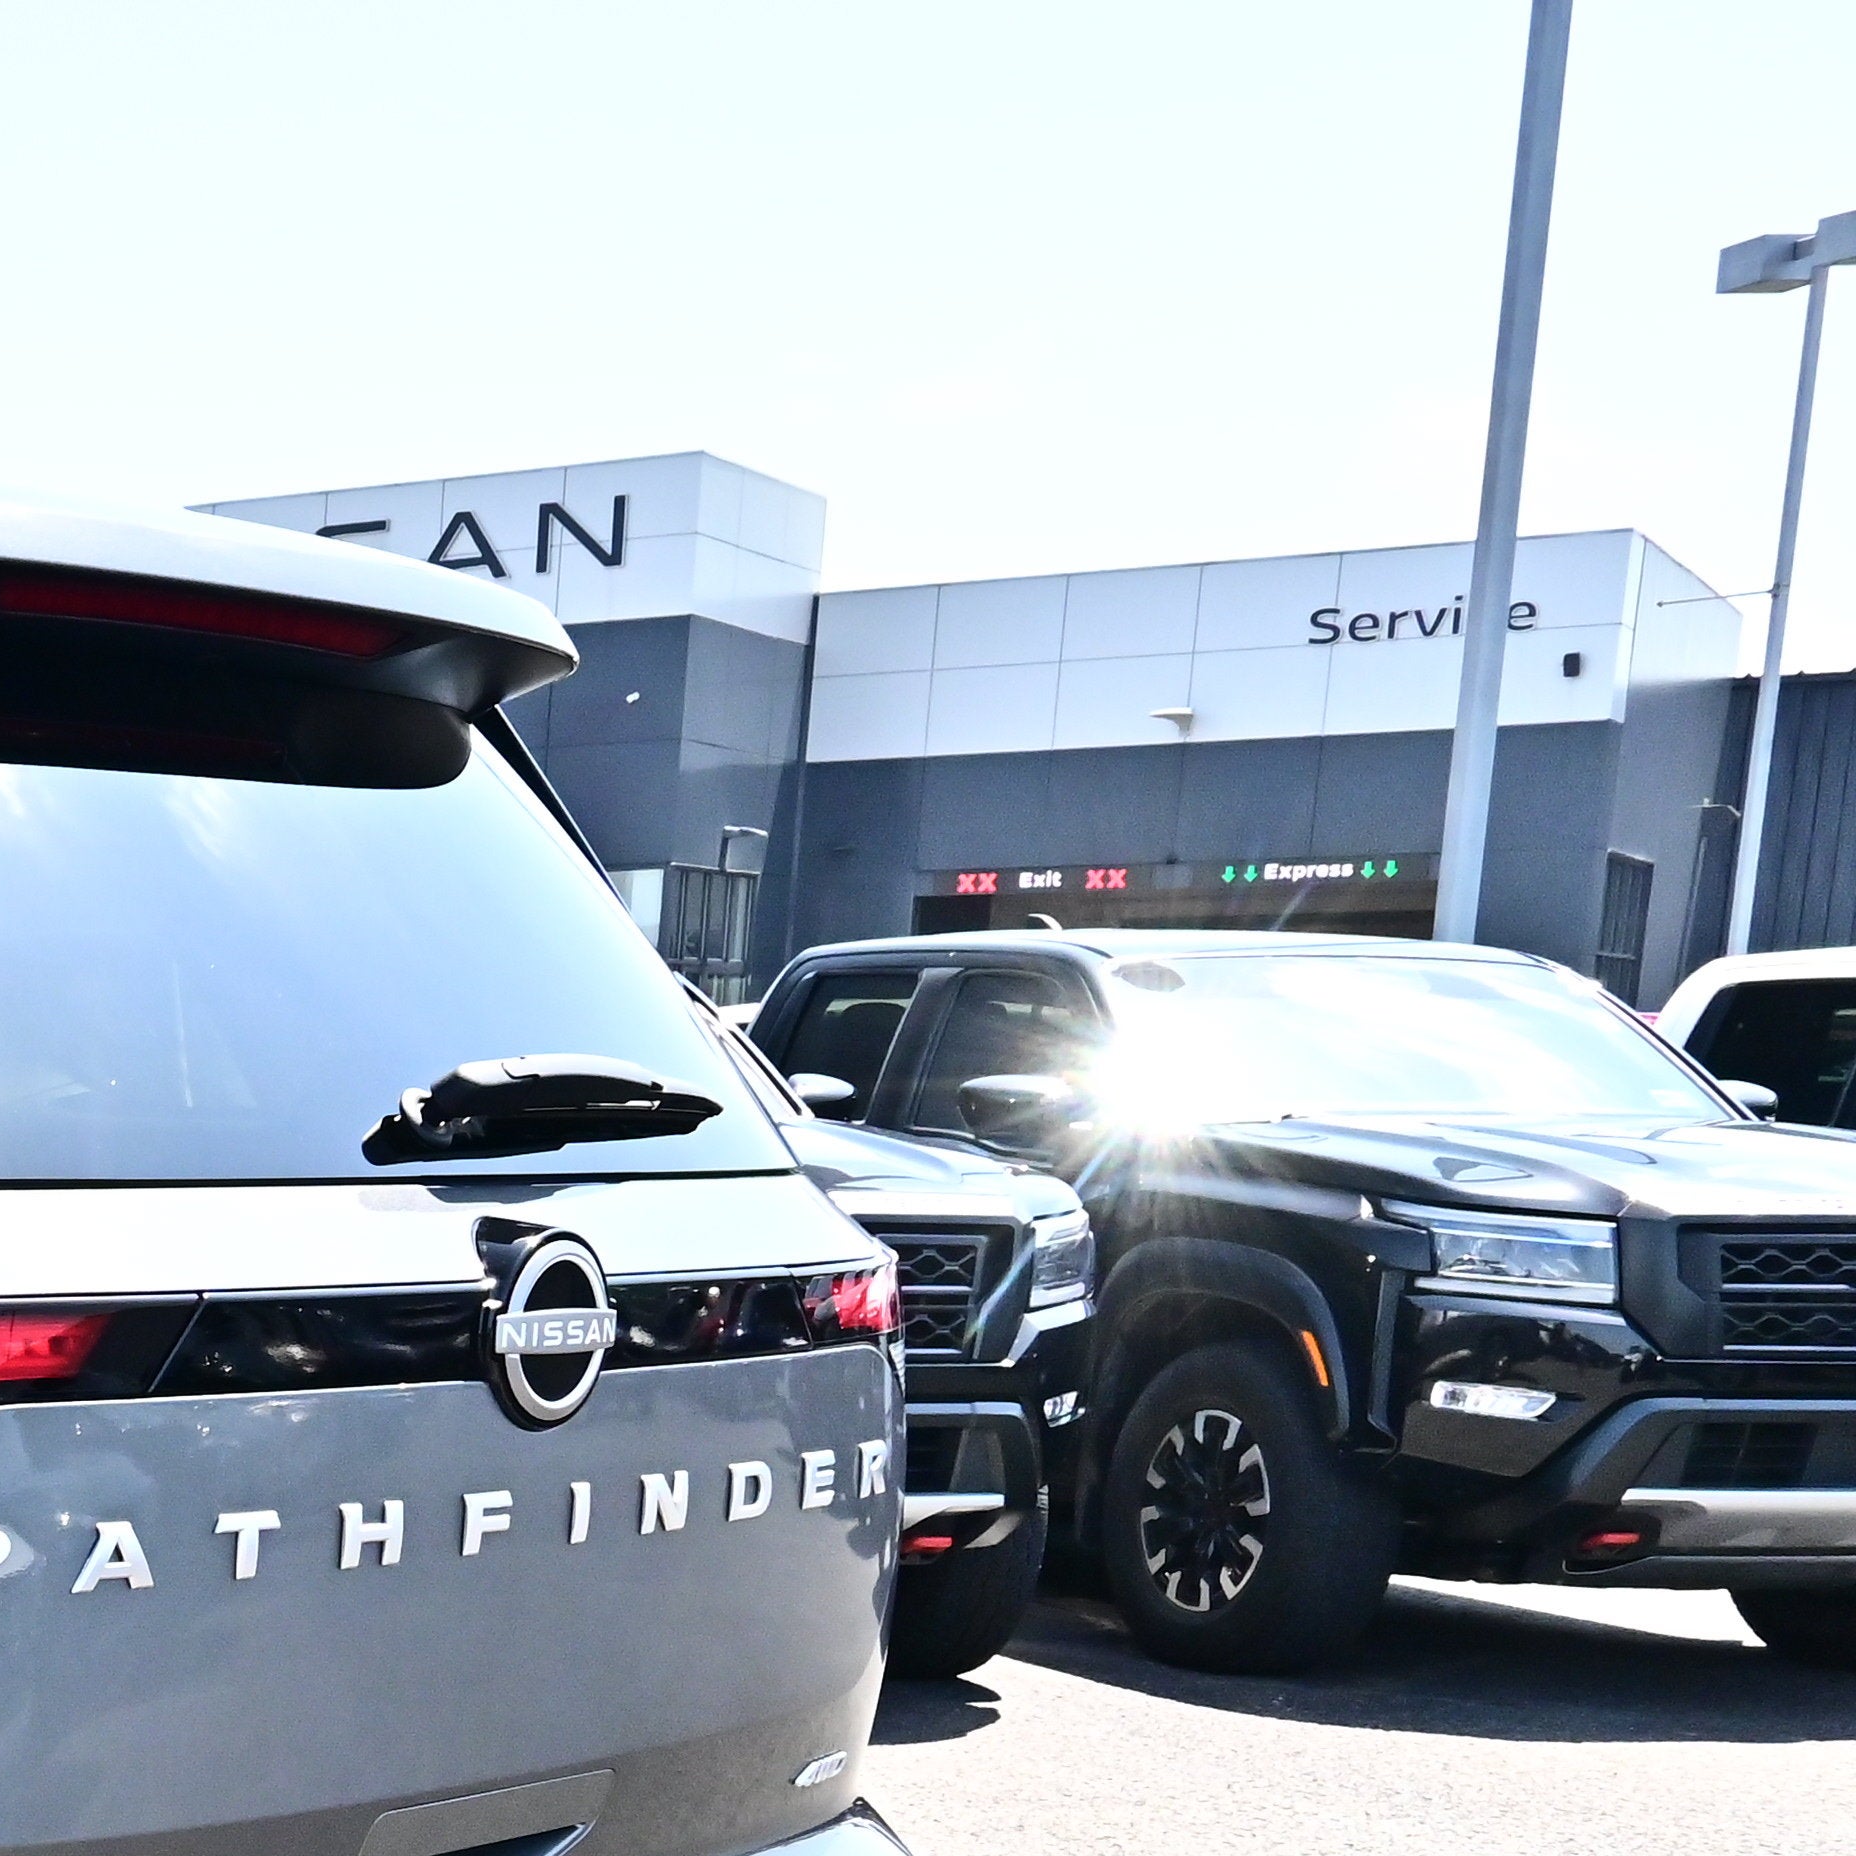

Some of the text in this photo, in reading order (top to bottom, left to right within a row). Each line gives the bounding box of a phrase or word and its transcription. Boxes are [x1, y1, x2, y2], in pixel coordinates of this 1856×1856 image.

[1308, 594, 1537, 645] Servie
[1019, 872, 1062, 889] Exit
[1264, 862, 1354, 881] Express
[501, 1318, 616, 1348] NISSAN
